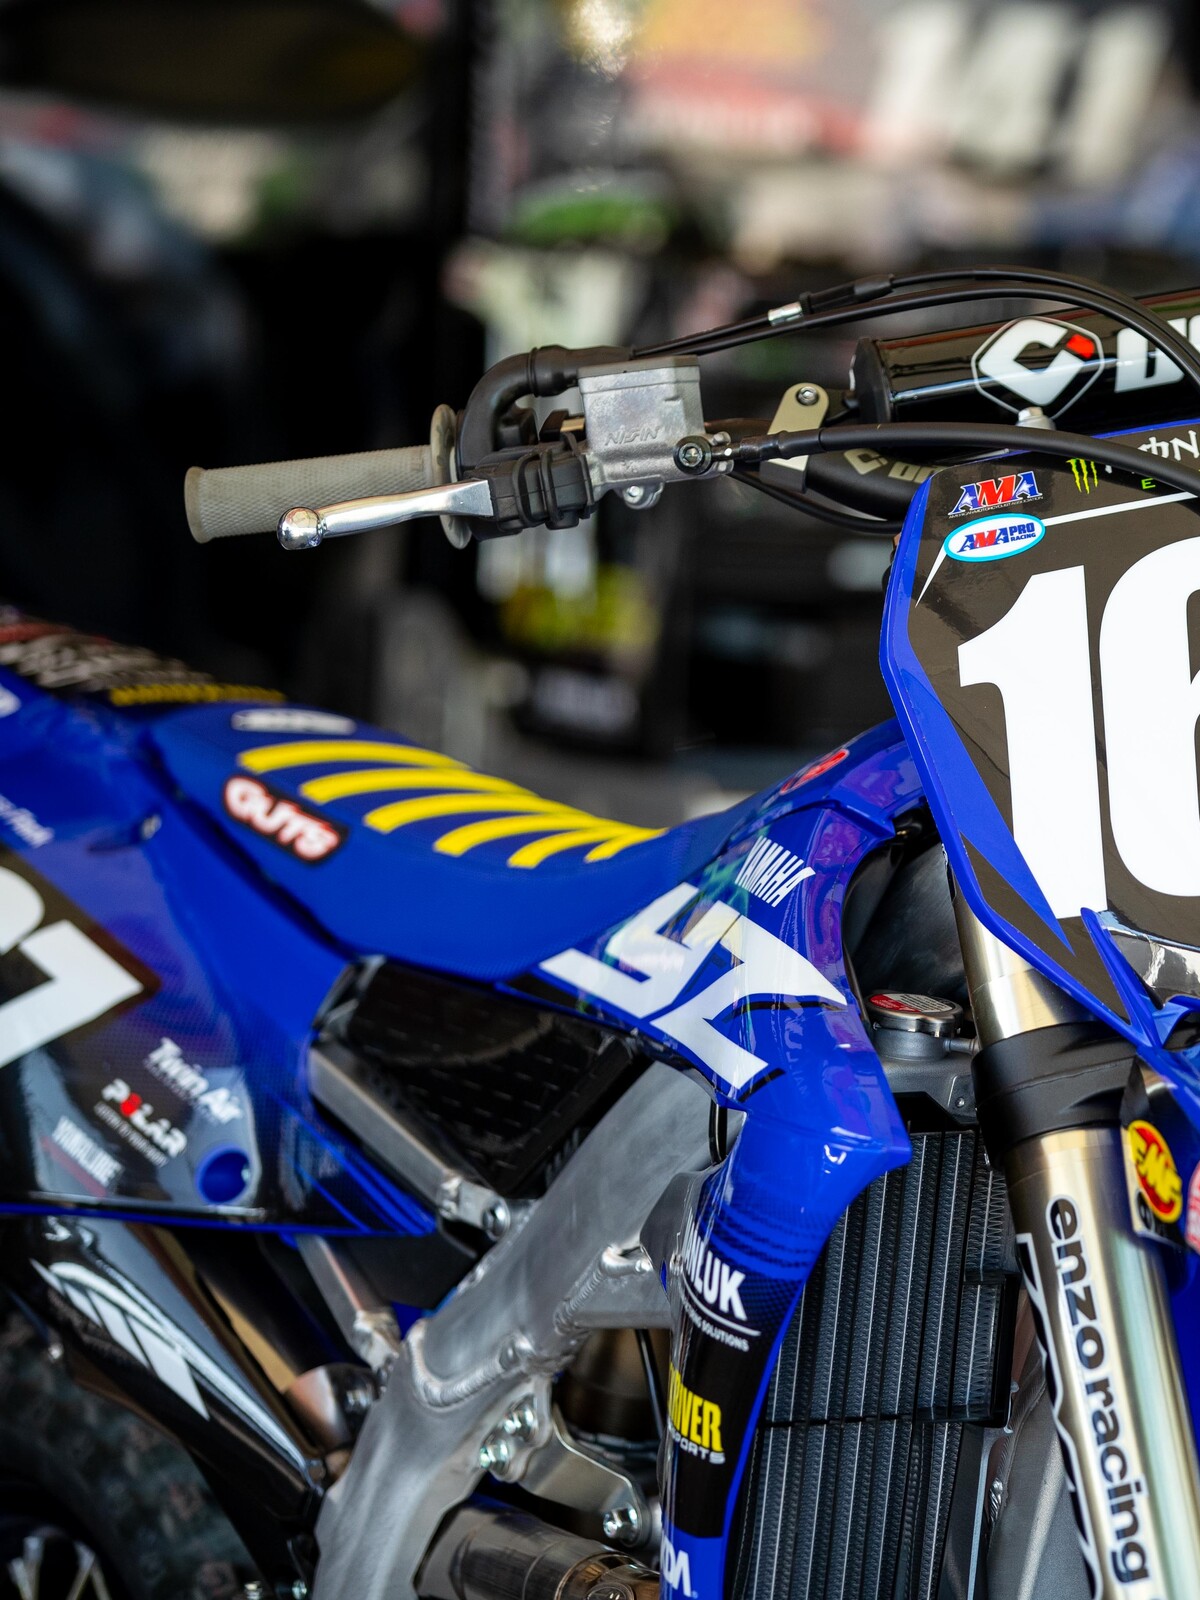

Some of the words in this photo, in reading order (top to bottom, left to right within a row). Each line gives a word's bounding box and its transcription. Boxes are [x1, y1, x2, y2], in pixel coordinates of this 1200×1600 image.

[948, 471, 1042, 515] AMA
[957, 527, 1010, 553] AMA
[1009, 522, 1035, 536] PRO
[1010, 532, 1036, 542] RACING
[225, 776, 340, 860] GUTS
[735, 836, 816, 907] YAMAHA
[1048, 1196, 1106, 1373] enzo
[1084, 1376, 1150, 1585] racing
